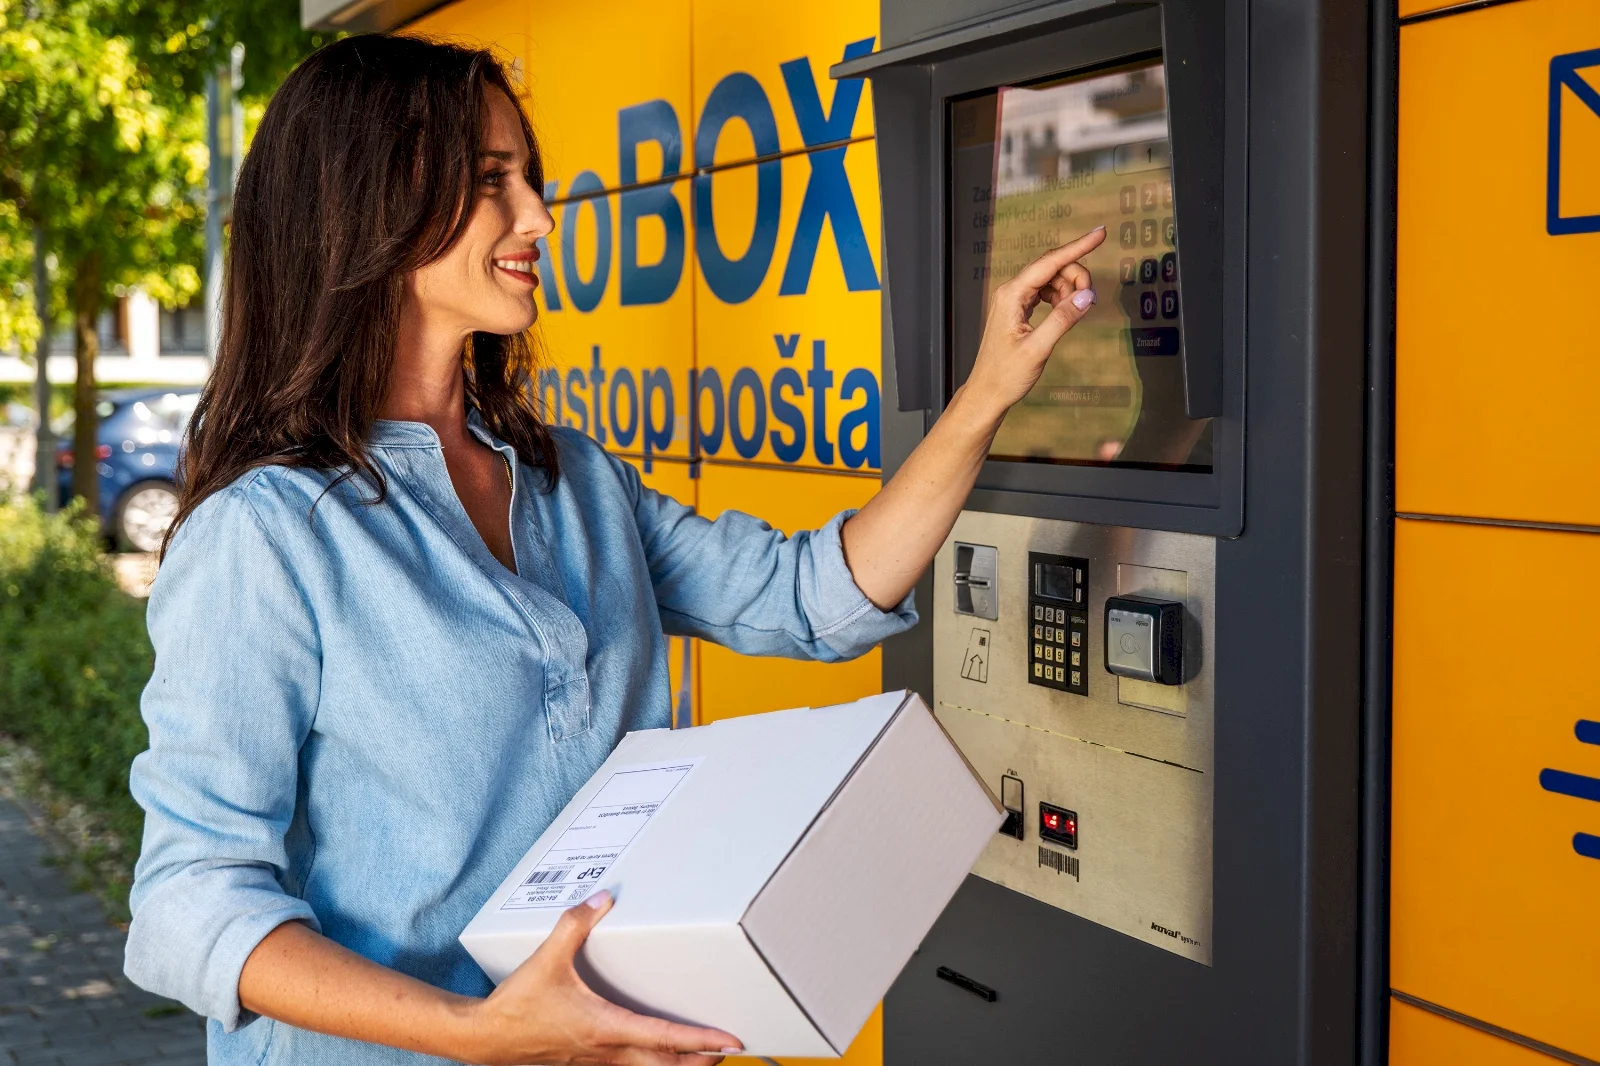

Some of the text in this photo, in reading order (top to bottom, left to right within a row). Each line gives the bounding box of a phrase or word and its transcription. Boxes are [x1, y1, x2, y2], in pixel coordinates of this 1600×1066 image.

[1146, 147, 1152, 164] 1
[1144, 189, 1153, 205] 2
[1123, 227, 1132, 244] 4
[1144, 225, 1153, 242] 5
[1123, 260, 1174, 280] 7 8 9
[517, 333, 881, 480] nstop pošta
[577, 866, 606, 880] ExP
